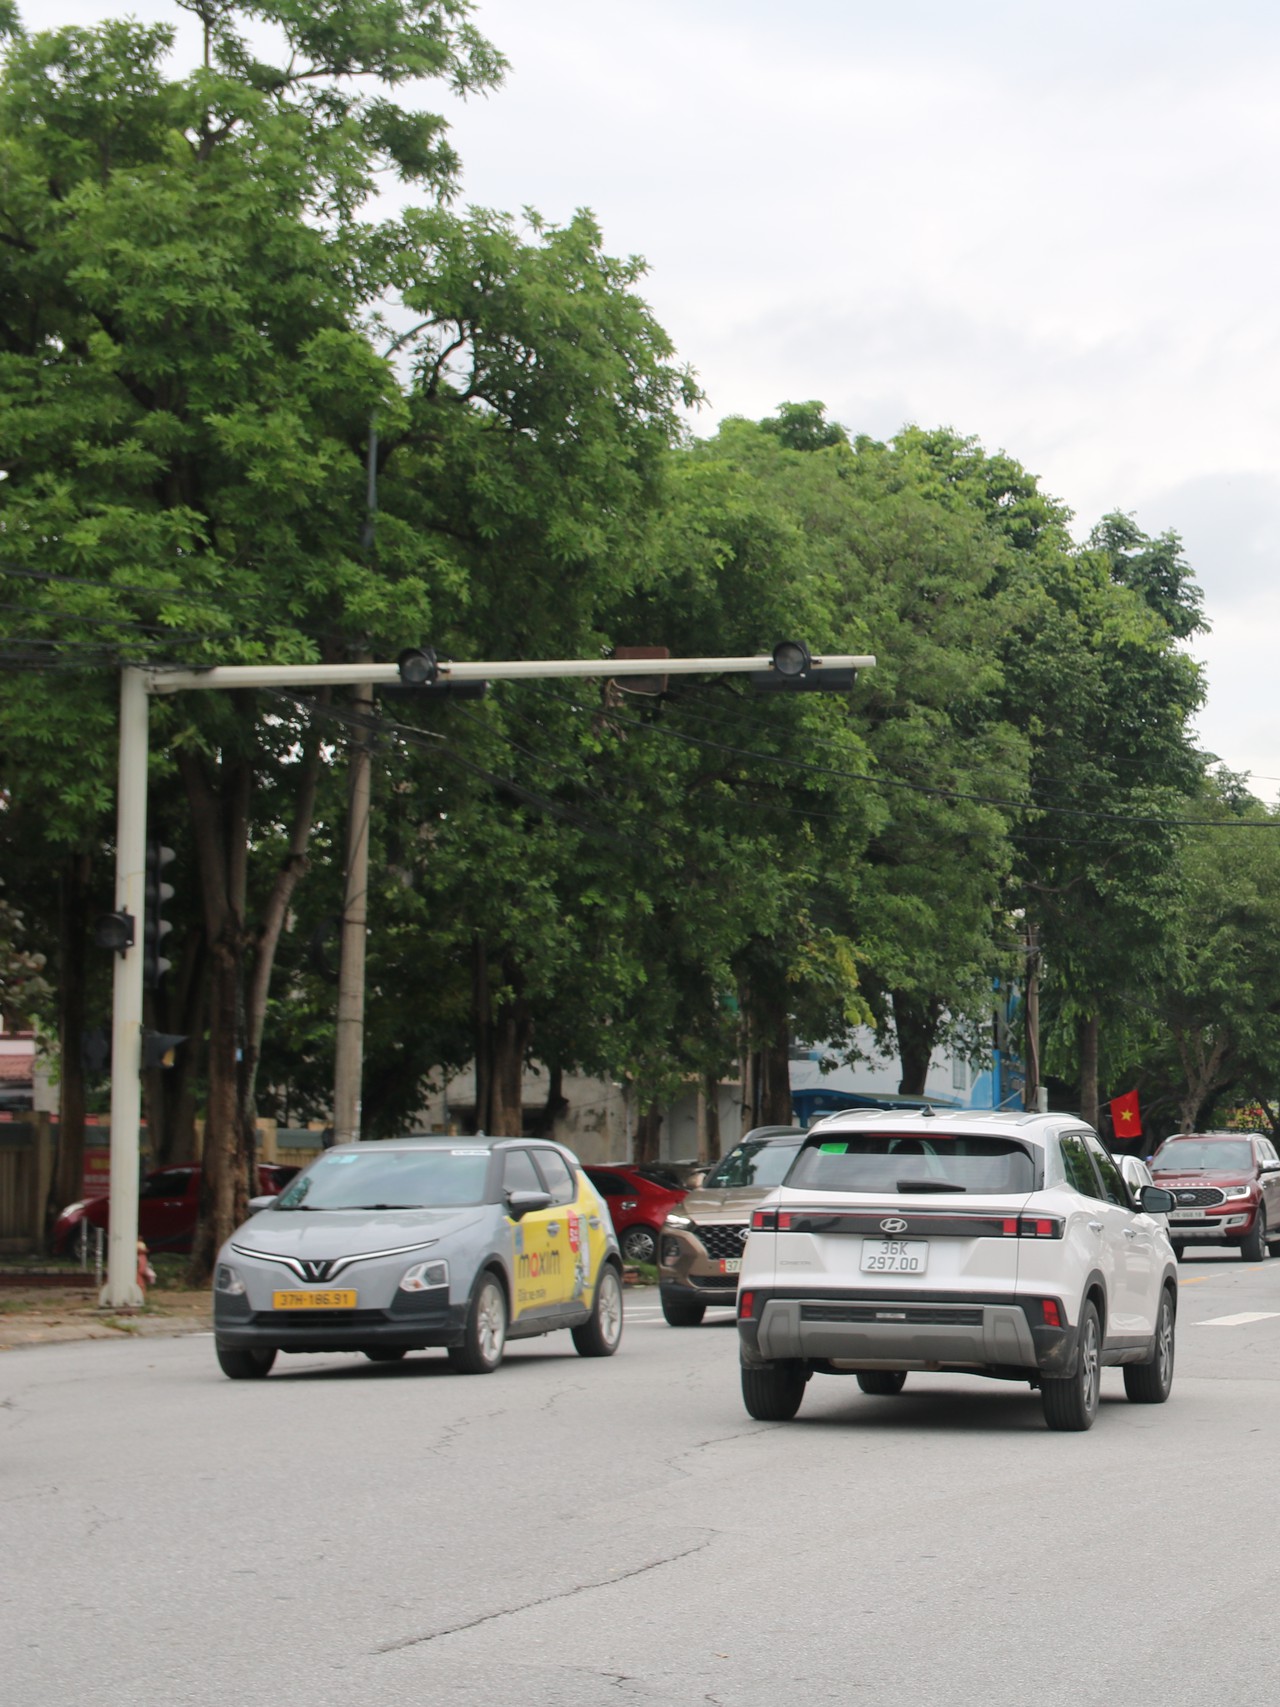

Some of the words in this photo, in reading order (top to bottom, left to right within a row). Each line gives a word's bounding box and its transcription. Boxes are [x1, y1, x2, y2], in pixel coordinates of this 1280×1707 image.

[881, 1242, 908, 1256] 36K
[518, 1245, 560, 1278] maxim
[726, 1260, 741, 1271] 37
[867, 1256, 919, 1271] 297.00
